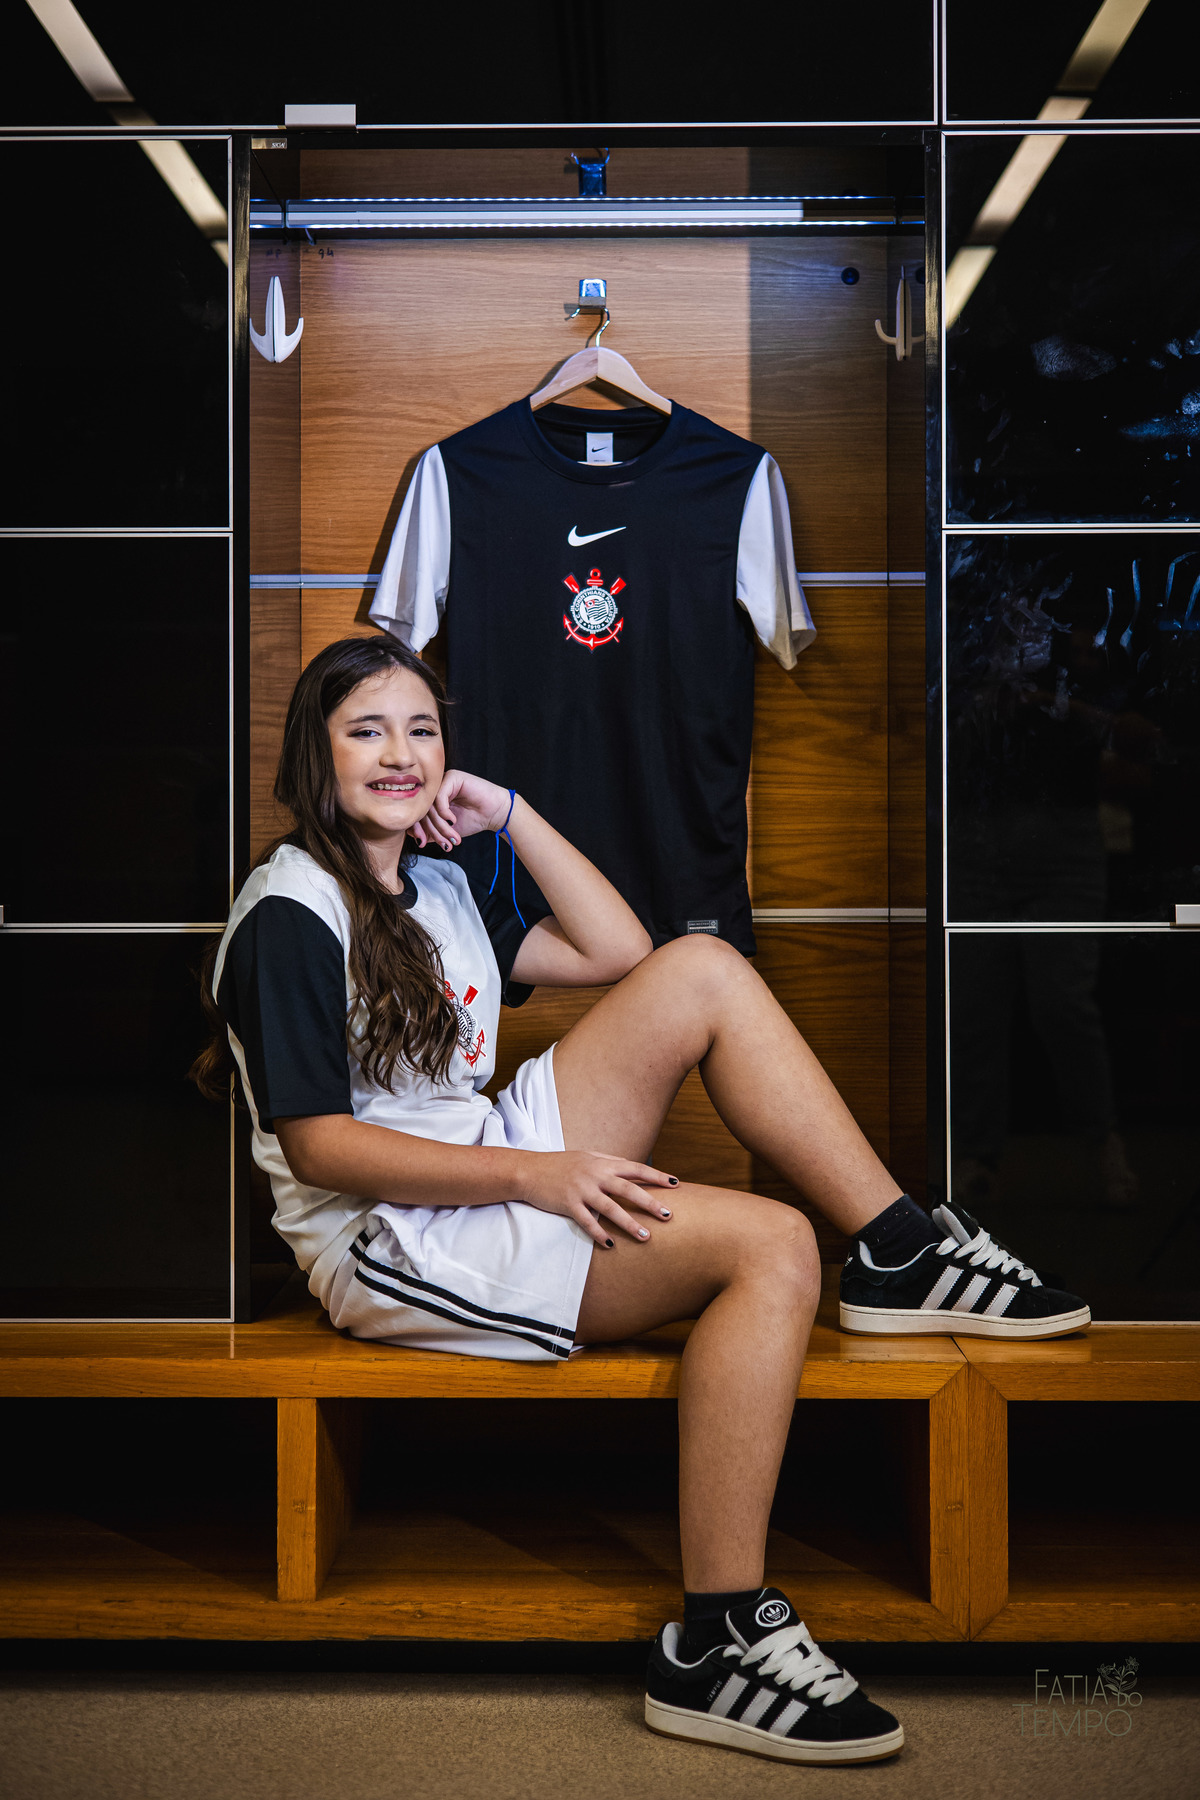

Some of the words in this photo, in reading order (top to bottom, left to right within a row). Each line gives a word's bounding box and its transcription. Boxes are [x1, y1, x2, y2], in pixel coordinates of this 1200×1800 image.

[318, 247, 334, 260] 94
[574, 590, 605, 612] CORINTHIANS
[604, 597, 614, 624] PAULISTA
